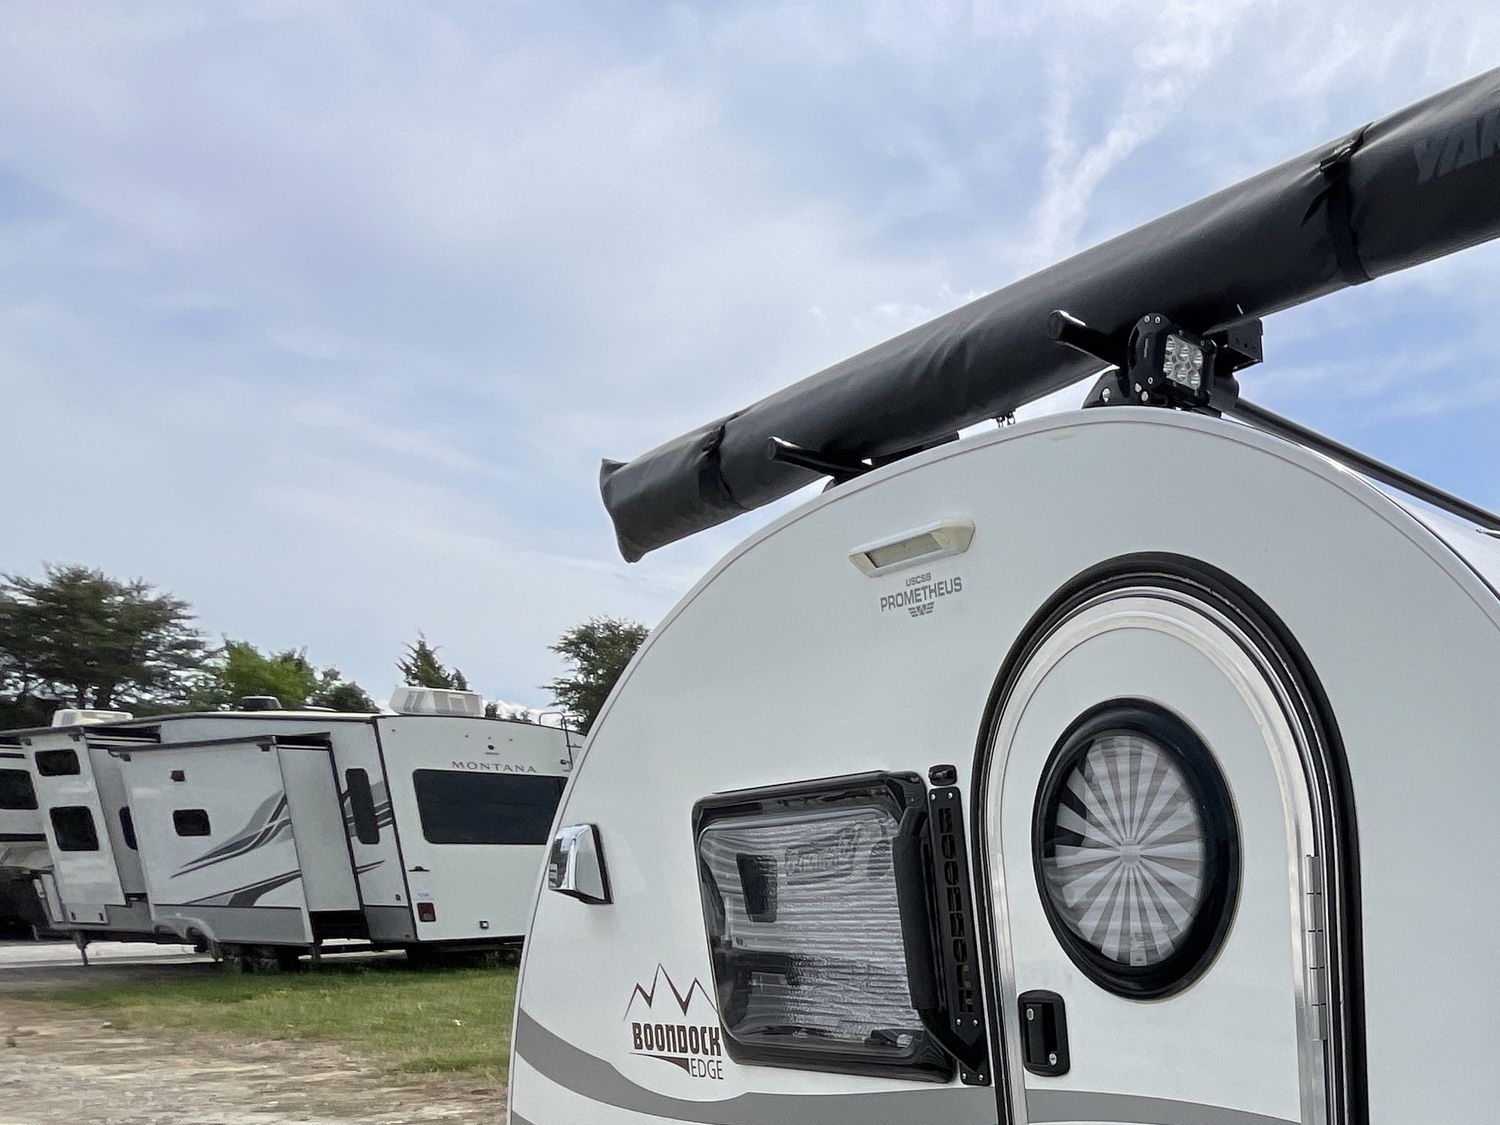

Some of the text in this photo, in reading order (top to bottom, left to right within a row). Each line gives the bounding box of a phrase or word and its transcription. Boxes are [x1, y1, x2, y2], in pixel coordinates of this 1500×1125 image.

[880, 577, 963, 612] PROMETHEUS
[452, 761, 537, 773] MONTANA
[631, 1022, 722, 1057] BOONDOCK
[690, 1058, 725, 1080] EDGE
